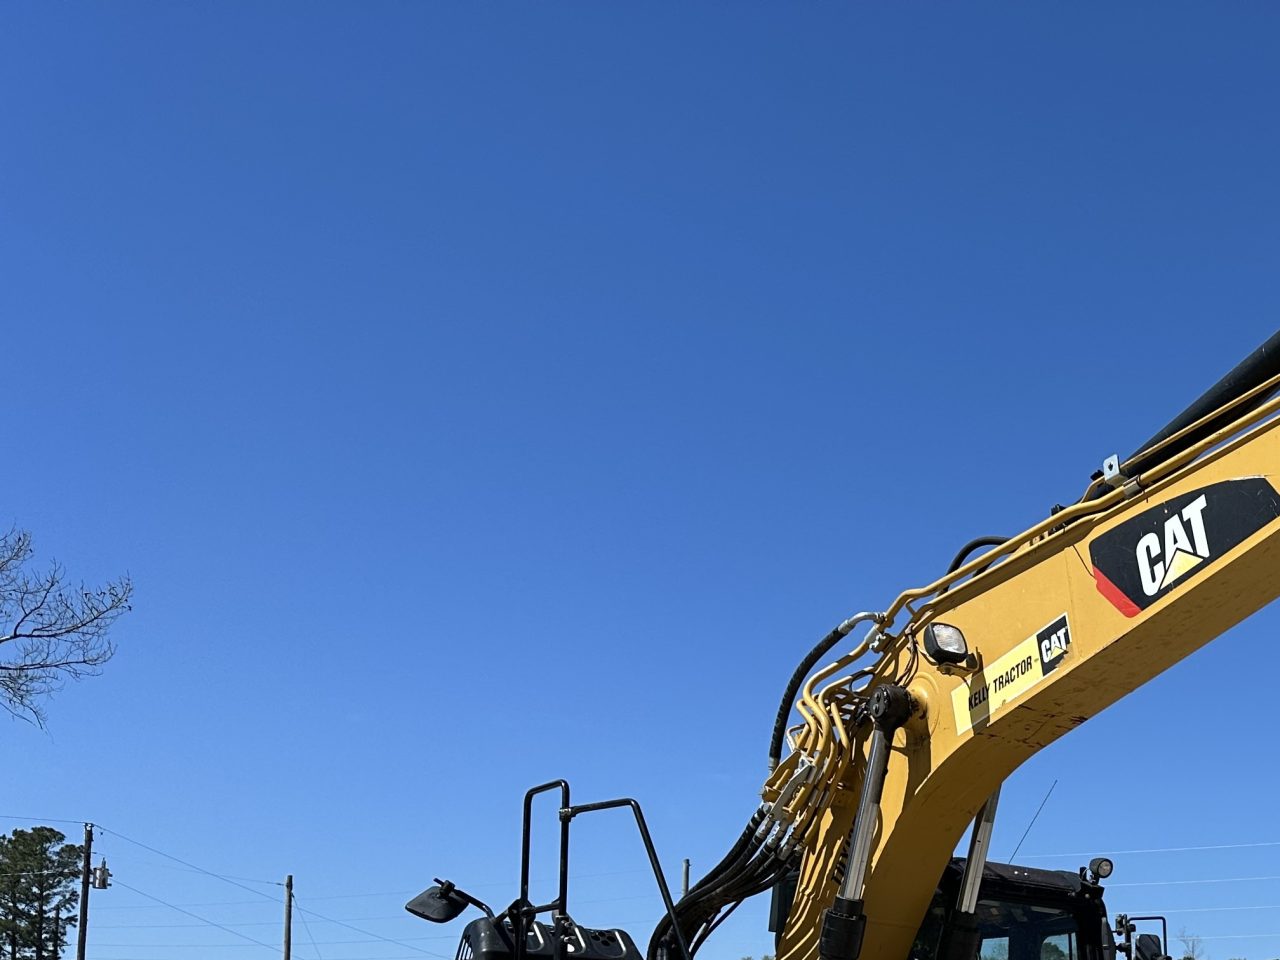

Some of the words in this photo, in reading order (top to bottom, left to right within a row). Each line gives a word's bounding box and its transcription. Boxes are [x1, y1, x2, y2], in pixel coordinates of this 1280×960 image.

[1136, 494, 1210, 596] CAT
[1041, 627, 1067, 663] CAT
[968, 683, 990, 711] KELLY
[992, 656, 1033, 693] TRACTOR
